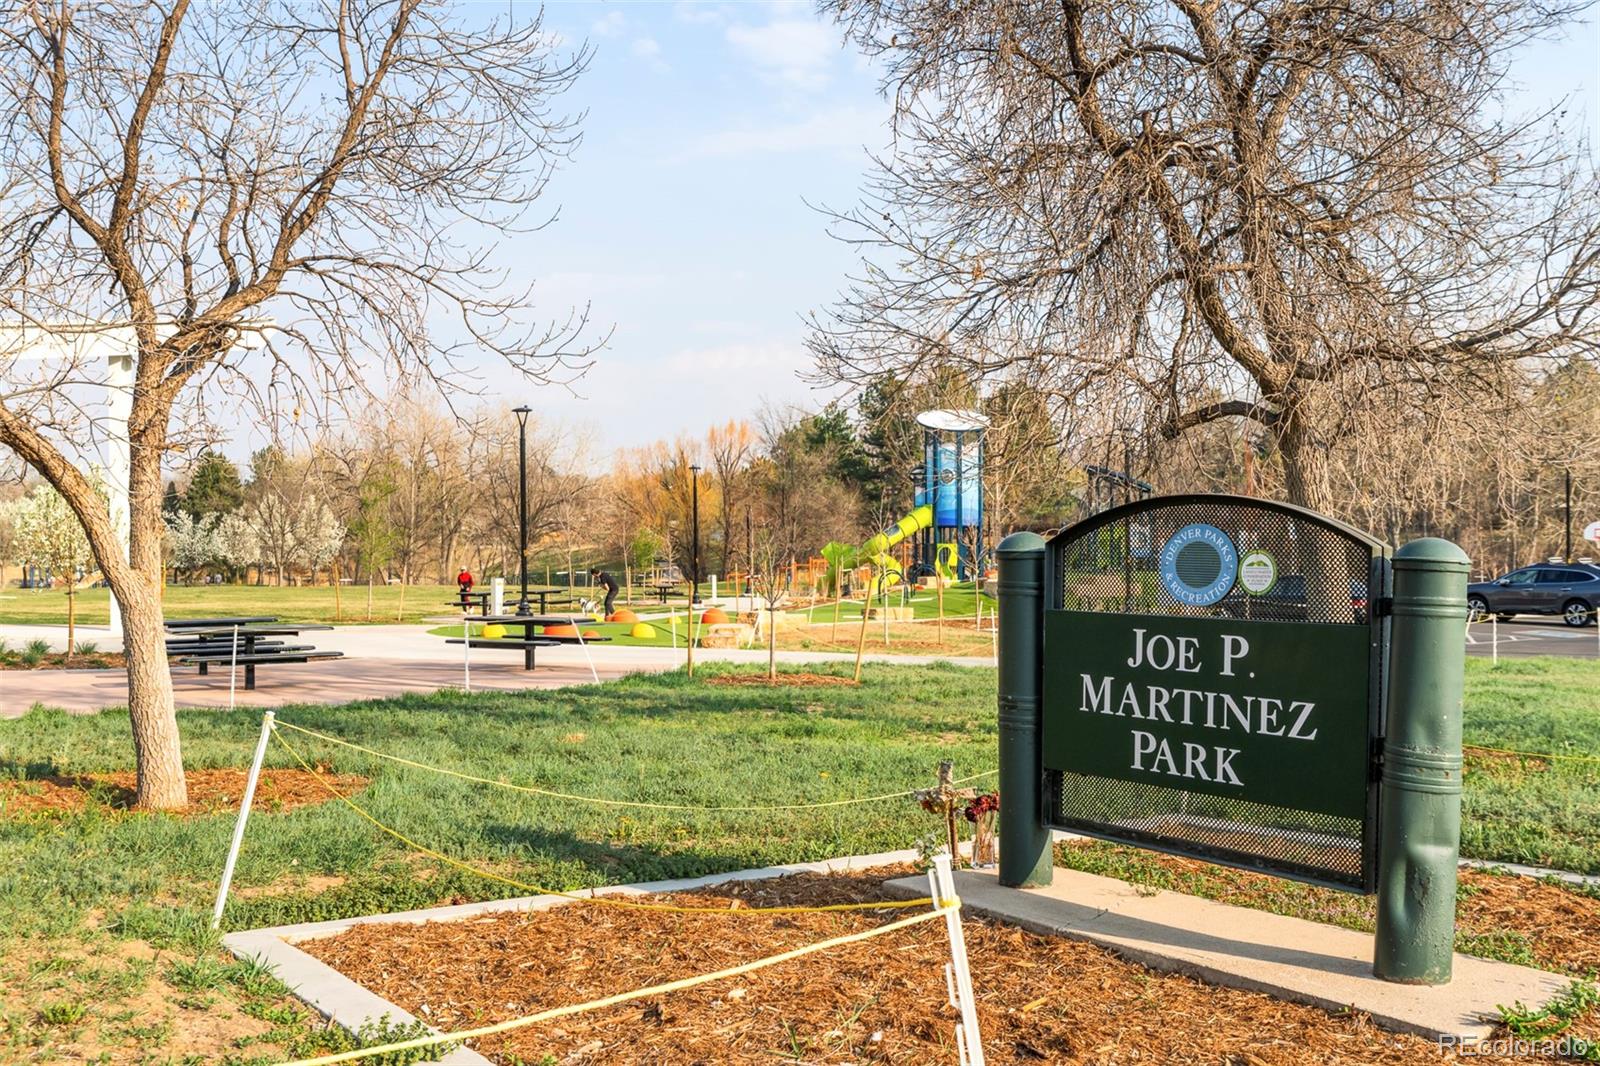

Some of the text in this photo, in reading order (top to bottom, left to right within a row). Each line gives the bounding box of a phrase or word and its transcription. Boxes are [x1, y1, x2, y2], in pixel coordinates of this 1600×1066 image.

[1165, 528, 1233, 562] DENVER PARKS
[1165, 572, 1173, 582] &
[1170, 573, 1231, 603] RECREATION
[1127, 628, 1255, 679] JOE P.
[1079, 673, 1318, 741] MARTINEZ
[1130, 729, 1245, 786] PARK
